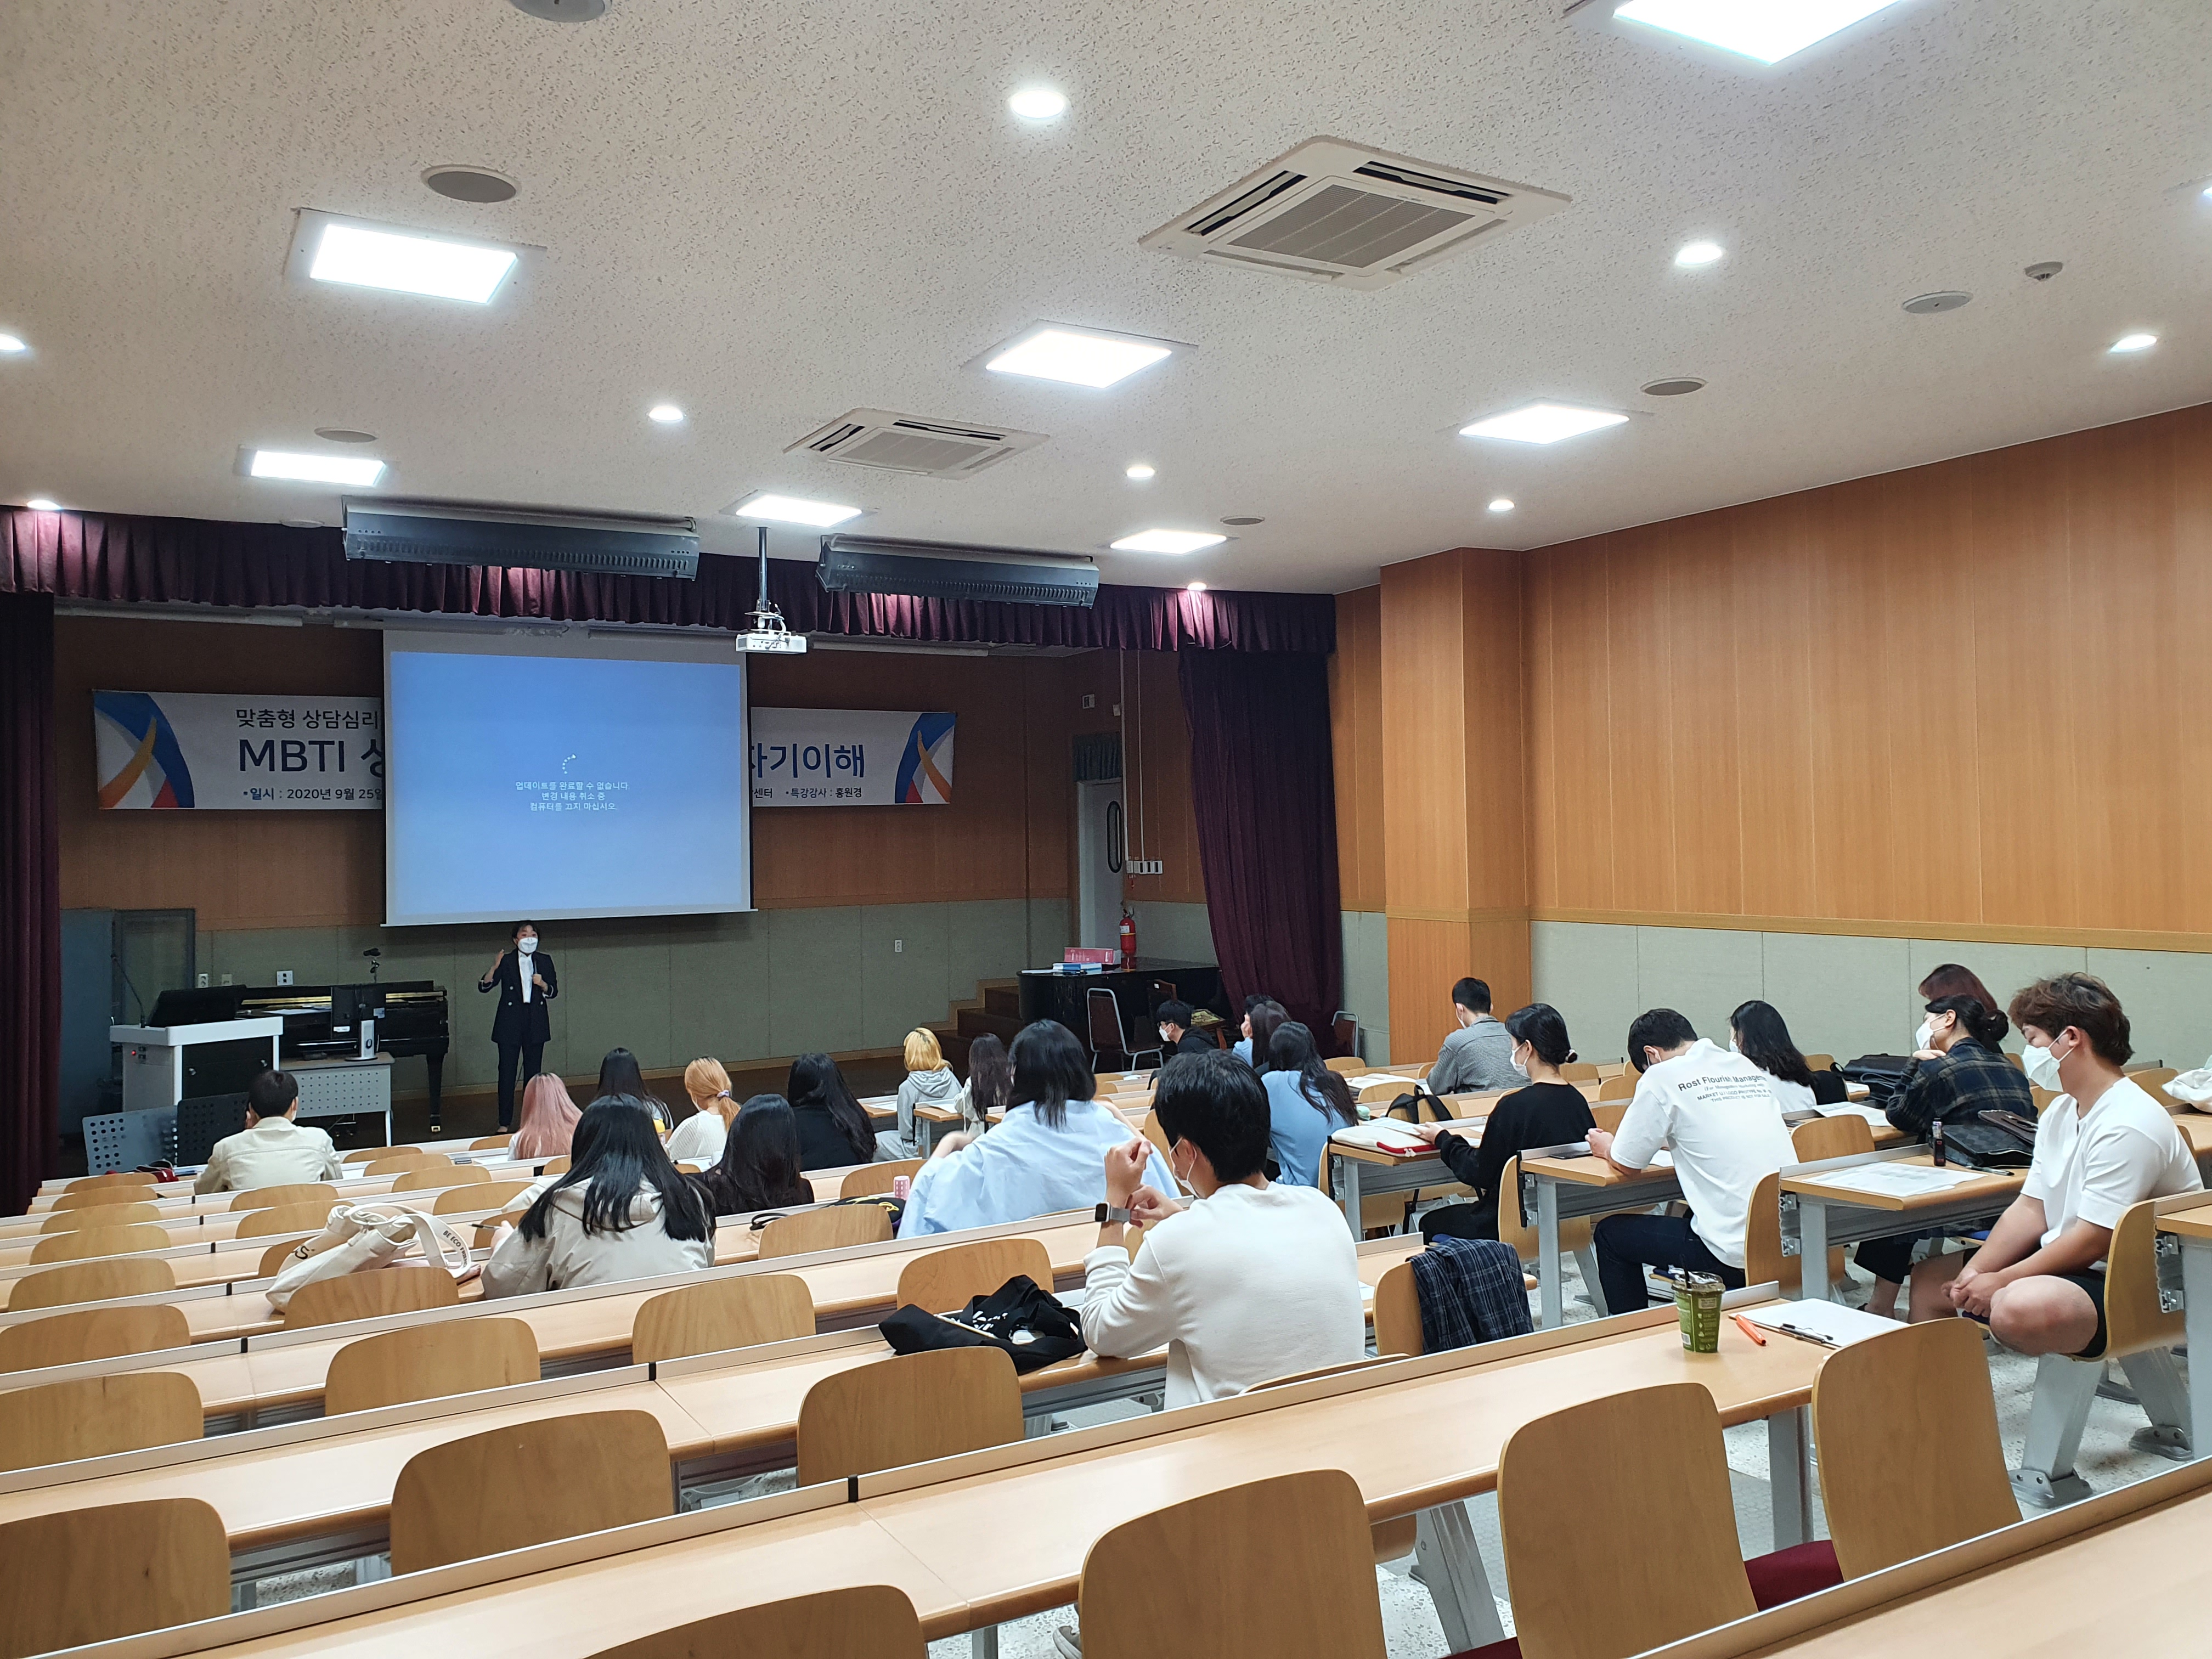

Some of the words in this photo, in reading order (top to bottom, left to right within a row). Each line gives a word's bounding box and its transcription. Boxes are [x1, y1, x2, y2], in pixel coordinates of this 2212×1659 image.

[236, 708, 295, 729] 맞춤형
[303, 709, 379, 730] 상담심리
[239, 739, 345, 772] MBTI
[516, 781, 557, 791] 업데이트를
[559, 781, 584, 791] 완료할
[586, 782, 594, 790] 수
[286, 788, 331, 800] 2020년
[335, 788, 355, 800] 9월
[541, 792, 558, 801] 변경
[560, 792, 577, 801] 내용
[579, 792, 595, 801] 취소
[597, 792, 606, 801] 중
[752, 788, 772, 799] 센터
[791, 787, 827, 799] 특강강사
[835, 787, 862, 798] 홍원경
[530, 803, 563, 812] 컴퓨터를
[1678, 1079, 1702, 1092] Rost
[1697, 1092, 1719, 1101] MARKET
[443, 1230, 452, 1238] BE
[450, 1236, 461, 1247] ECO
